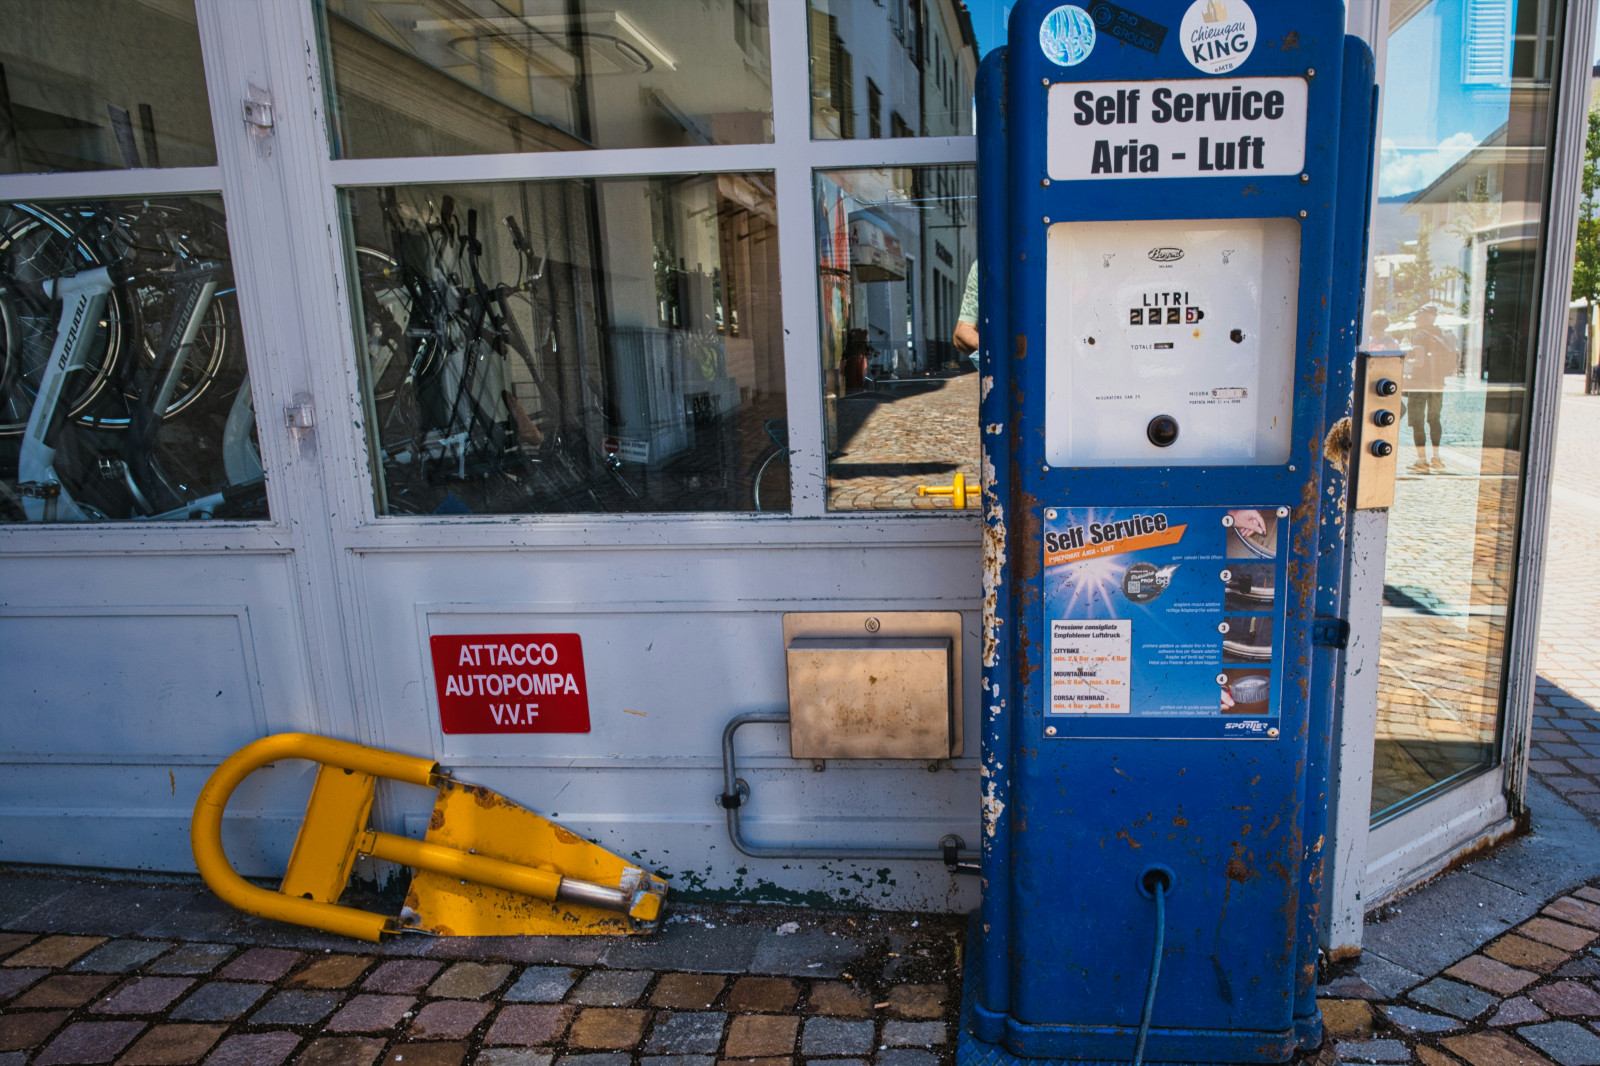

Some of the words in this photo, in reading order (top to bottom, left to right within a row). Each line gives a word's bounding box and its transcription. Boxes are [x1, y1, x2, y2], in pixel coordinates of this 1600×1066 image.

[1118, 11, 1138, 26] 2ND
[1112, 25, 1154, 49] GROUND
[1191, 22, 1245, 42] Chiemgau
[1192, 34, 1248, 63] KING
[1214, 63, 1233, 72] eMTB
[1073, 89, 1140, 126] Self
[1151, 86, 1284, 123] Service
[1091, 139, 1159, 174] Aria
[1199, 136, 1265, 170] Luft
[1143, 292, 1188, 306] LITRI
[58, 294, 88, 371] montana
[1045, 526, 1084, 553] Self
[1090, 513, 1168, 544] Service
[459, 643, 558, 666] ATTACCO
[445, 673, 579, 696] AUTOPOMPA
[489, 704, 539, 725] V.V.F
[1225, 720, 1268, 731] SPORTLER
